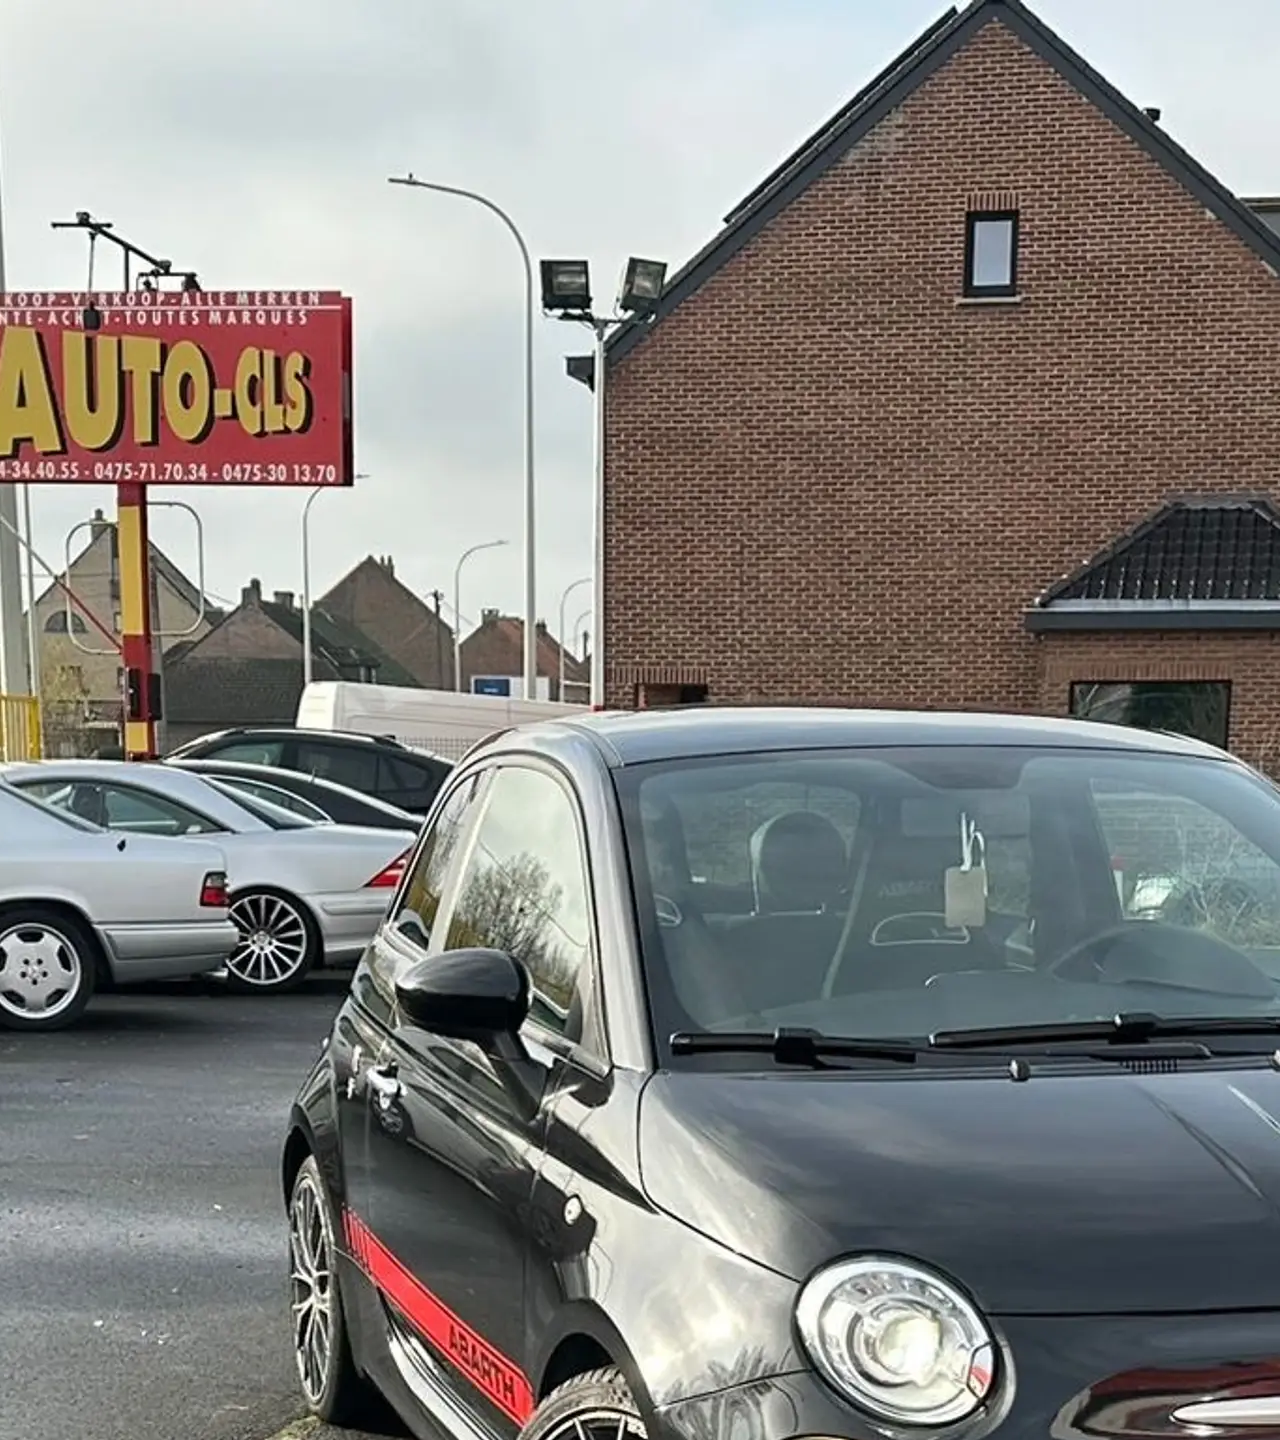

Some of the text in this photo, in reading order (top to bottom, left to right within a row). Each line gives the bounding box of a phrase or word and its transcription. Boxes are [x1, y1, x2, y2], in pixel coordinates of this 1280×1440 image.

[236, 291, 320, 305] MERKEN
[208, 310, 308, 326] MARQUES
[94, 462, 208, 481] 0475-71.70.34
[222, 463, 287, 482] 0475-30
[293, 464, 337, 482] 13.70
[449, 1323, 517, 1409] ABARTH
